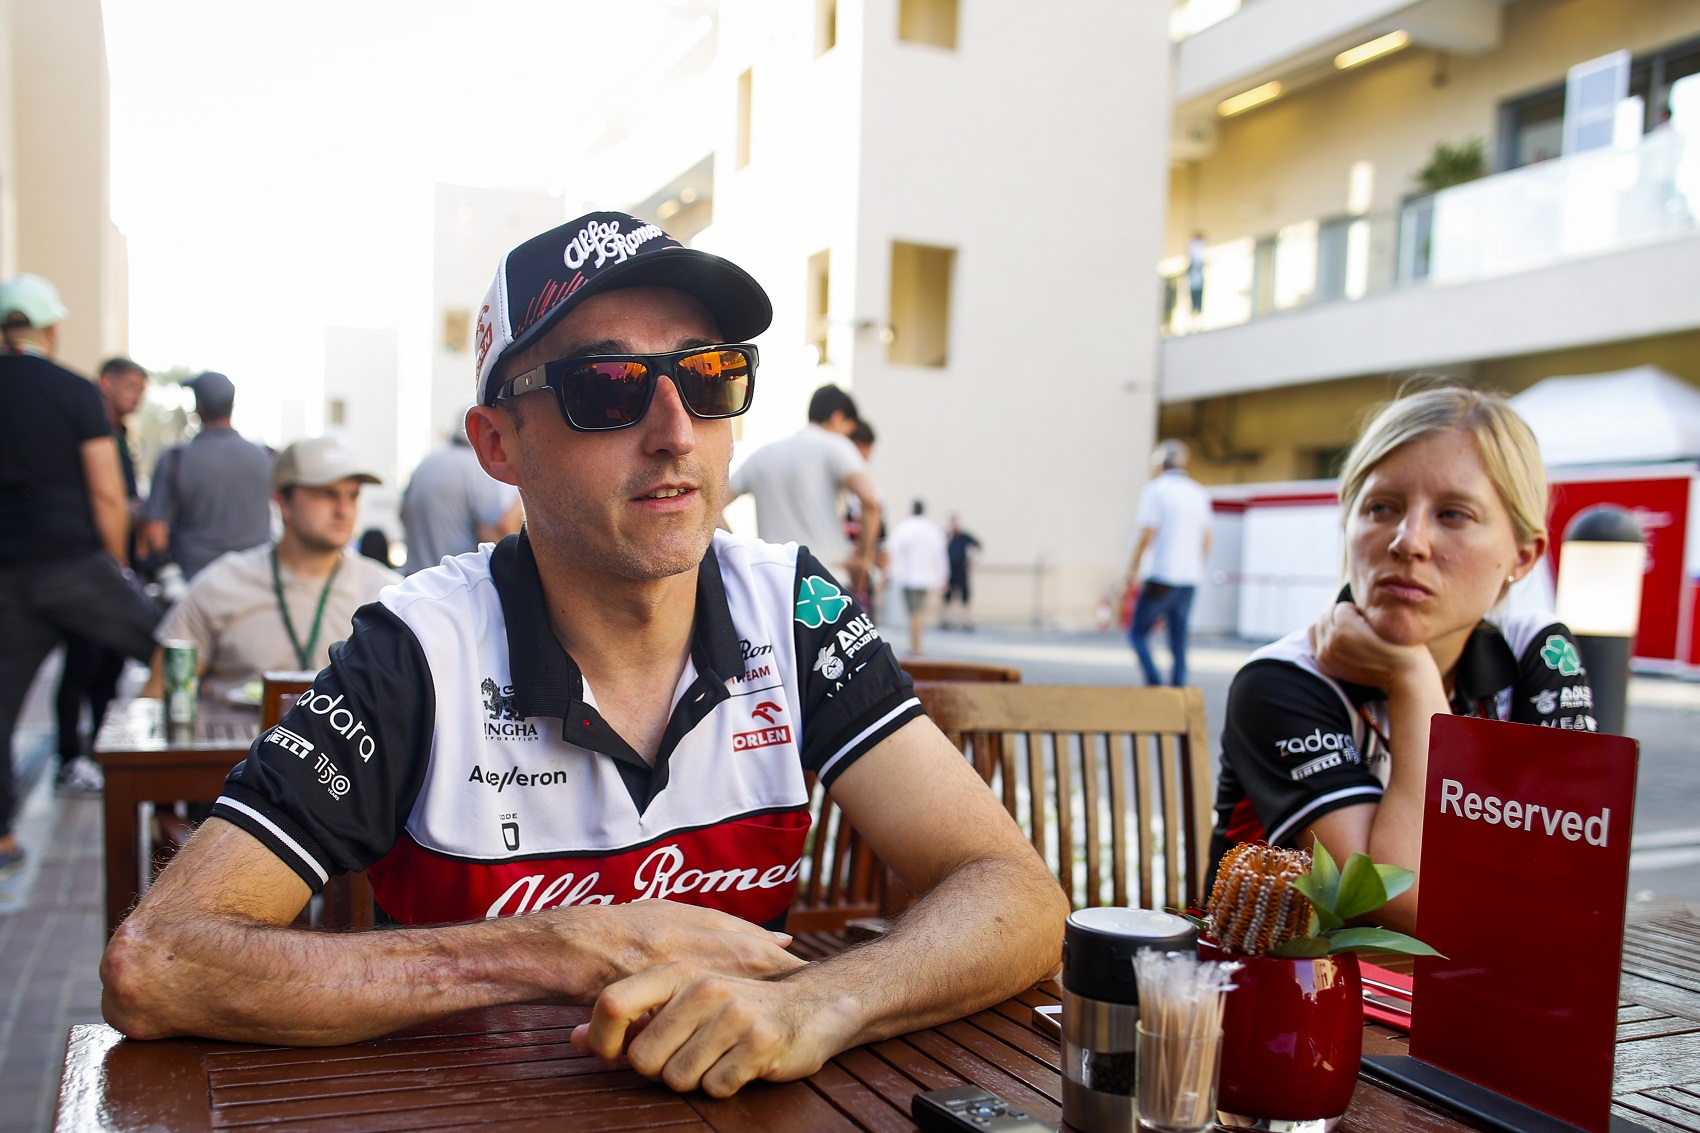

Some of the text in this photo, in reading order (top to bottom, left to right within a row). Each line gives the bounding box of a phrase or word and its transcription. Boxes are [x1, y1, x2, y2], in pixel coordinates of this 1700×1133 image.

[563, 220, 613, 270] Alfa
[836, 613, 875, 651] ADLE
[263, 725, 315, 759] ELLI
[296, 688, 376, 763] adara
[484, 723, 538, 737] INGHA
[733, 727, 788, 750] ORLEN
[327, 786, 341, 801] YEARS
[1440, 778, 1611, 848] Reserved
